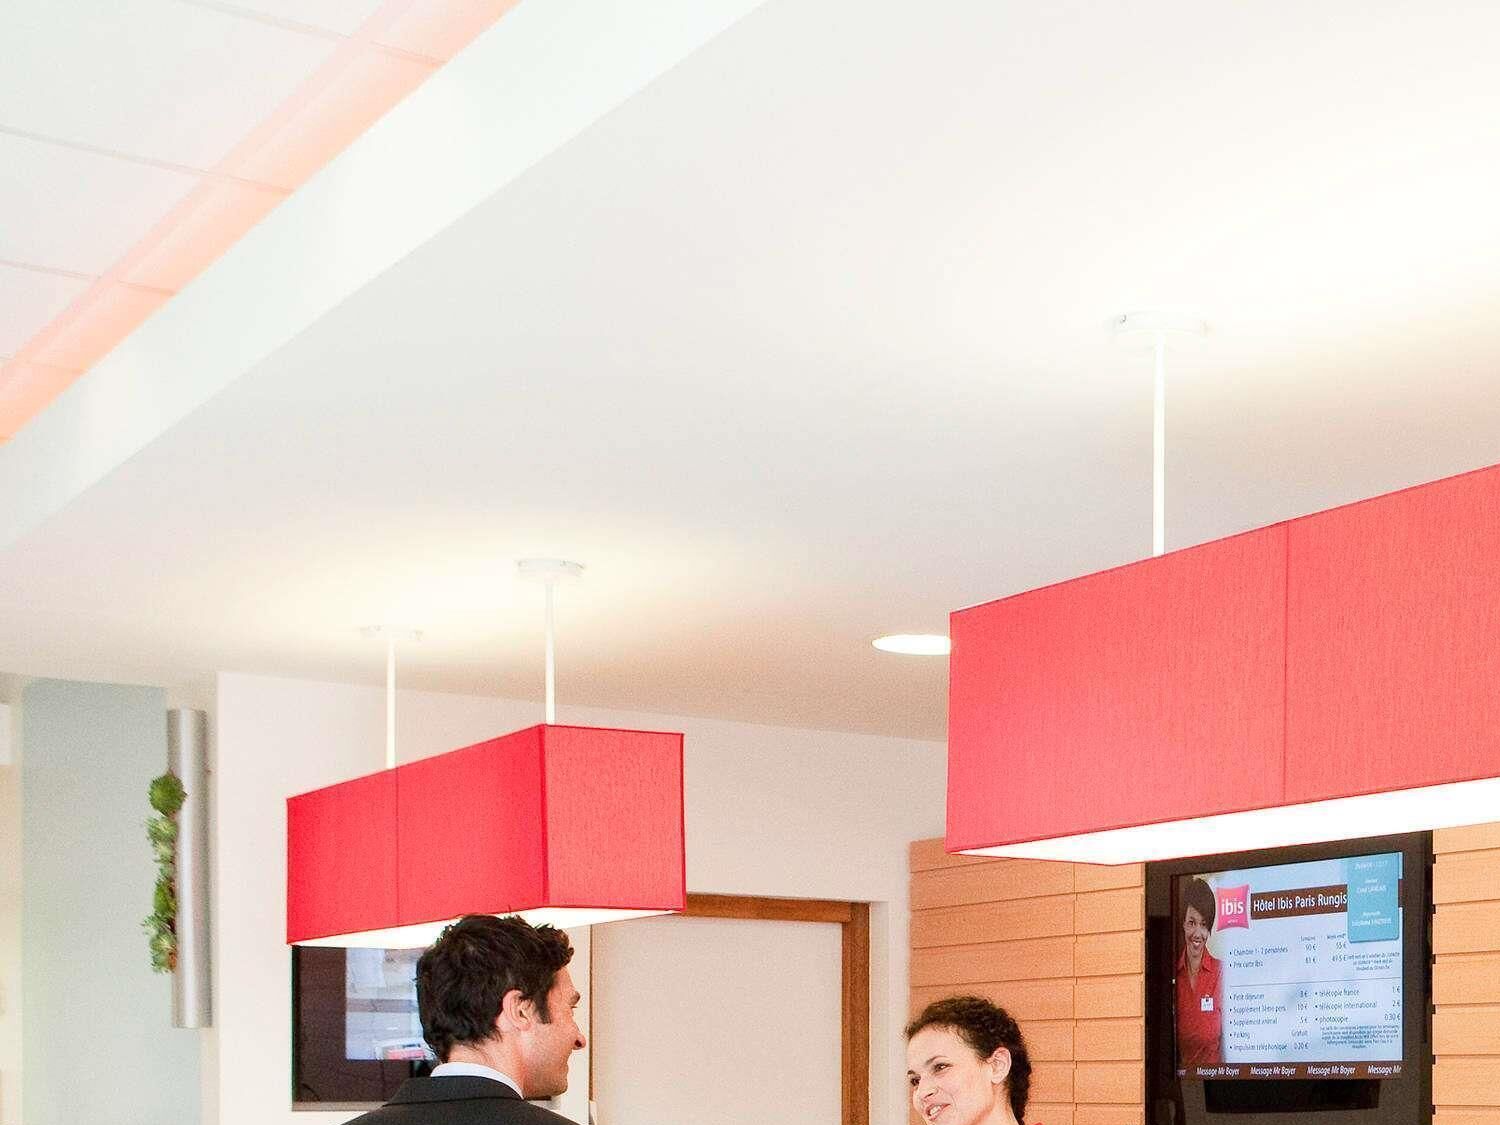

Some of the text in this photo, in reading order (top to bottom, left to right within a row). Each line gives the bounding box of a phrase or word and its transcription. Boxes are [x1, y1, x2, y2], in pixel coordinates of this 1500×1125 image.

[1221, 898, 1245, 916] ibis
[1253, 892, 1348, 912] Hôtel Ibis Paris Rungis
[1196, 1067, 1218, 1077] Message
[1250, 1066, 1273, 1077] Message
[1307, 1066, 1331, 1077] Message
[1367, 1065, 1392, 1076] Message
